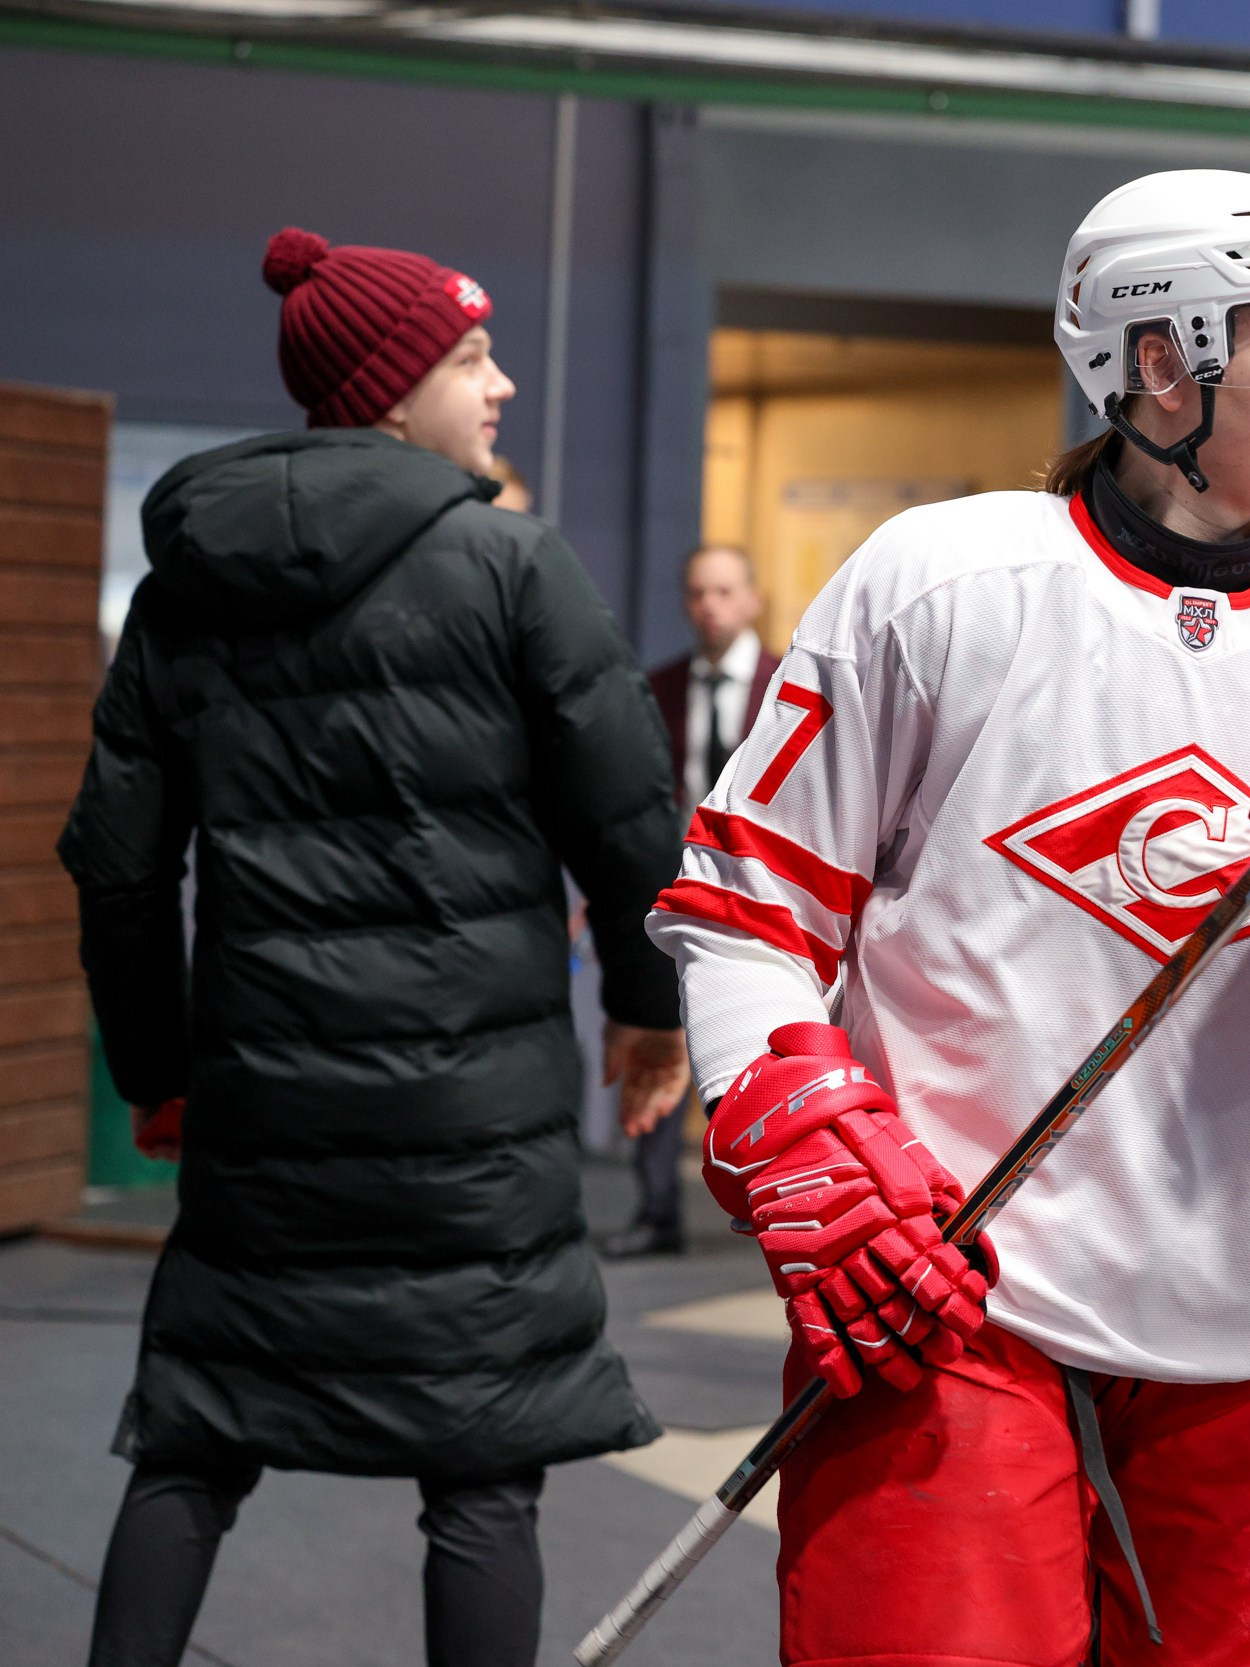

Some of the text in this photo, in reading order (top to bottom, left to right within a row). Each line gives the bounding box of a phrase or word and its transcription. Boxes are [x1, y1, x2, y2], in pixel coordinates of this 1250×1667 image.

[1111, 281, 1173, 299] CCM
[1195, 368, 1222, 381] CCM
[1183, 605, 1214, 620] МХЛ
[747, 680, 834, 807] 7
